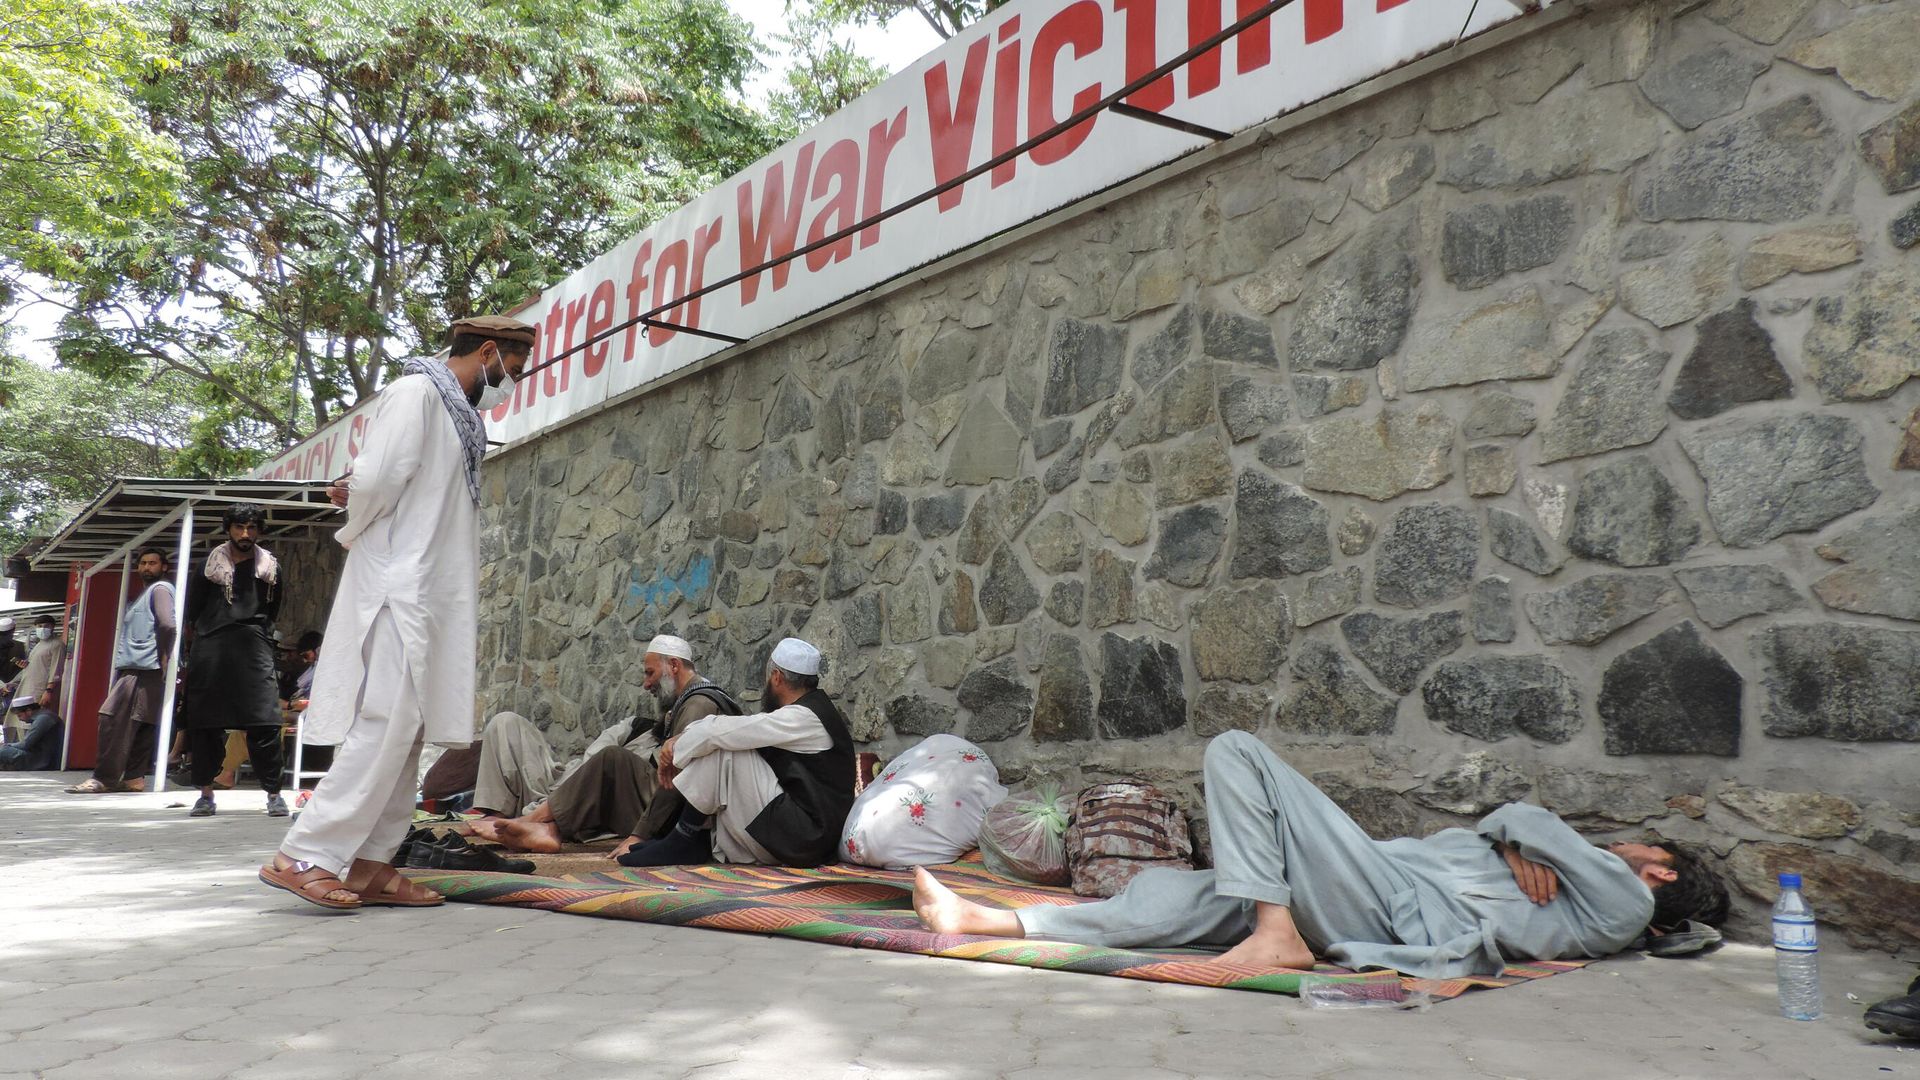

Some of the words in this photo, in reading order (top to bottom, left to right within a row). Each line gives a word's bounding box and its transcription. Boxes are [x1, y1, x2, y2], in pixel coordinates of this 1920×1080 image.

[479, 296, 615, 422] ntre
[623, 217, 722, 363] for
[737, 106, 907, 307] War
[924, 0, 1411, 214] Vict
